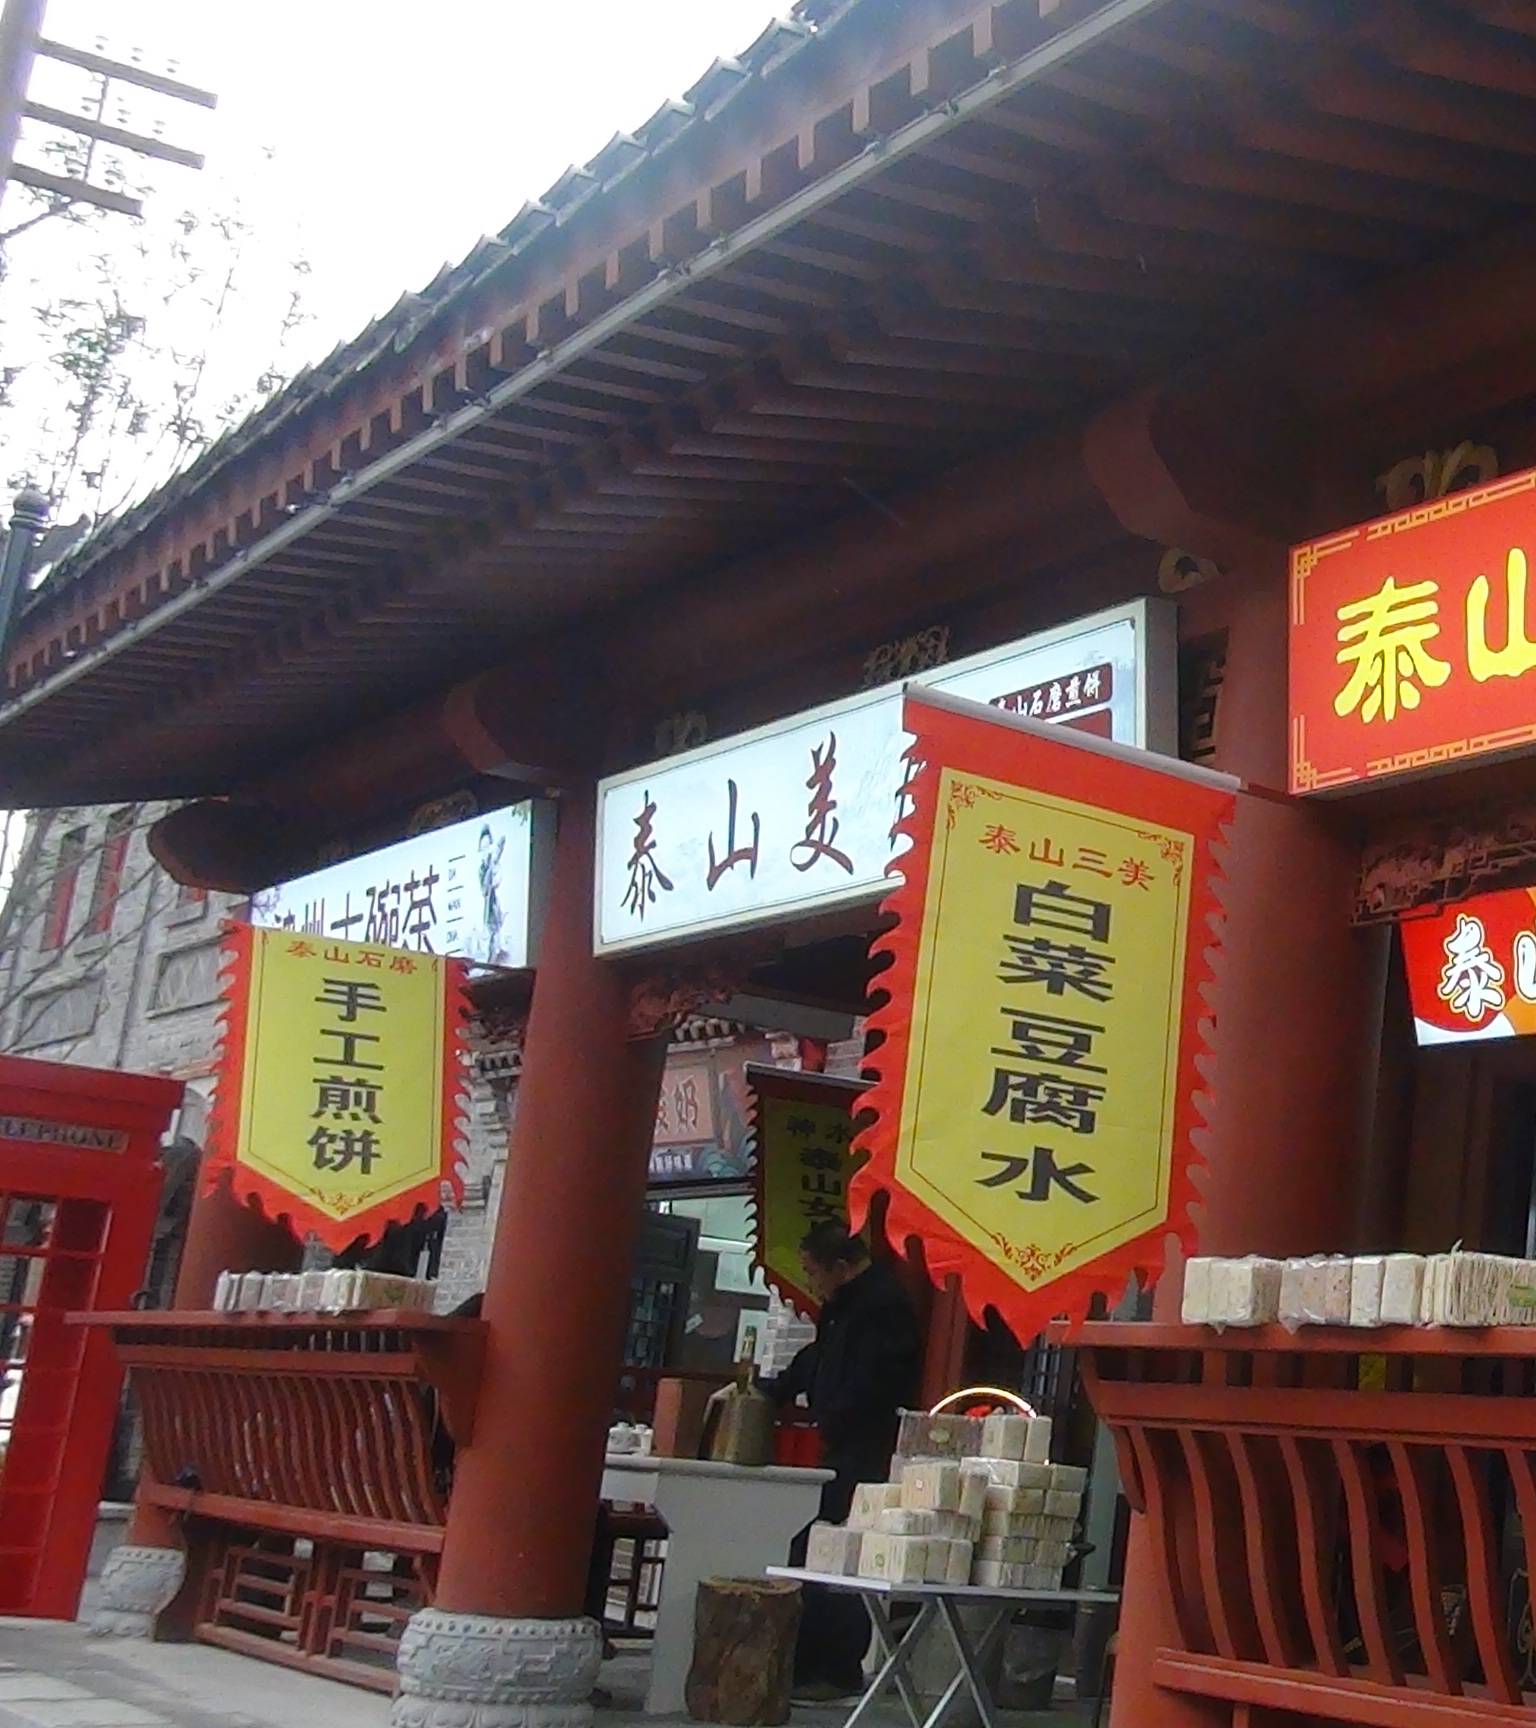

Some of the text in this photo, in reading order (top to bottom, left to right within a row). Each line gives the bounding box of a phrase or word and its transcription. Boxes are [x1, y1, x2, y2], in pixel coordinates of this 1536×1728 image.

[978, 822, 1156, 893] 泰山三美
[287, 940, 418, 975] 泰山石磨
[308, 978, 387, 1176] 手工煎饼
[975, 880, 1117, 1203] 白菜豆腐水
